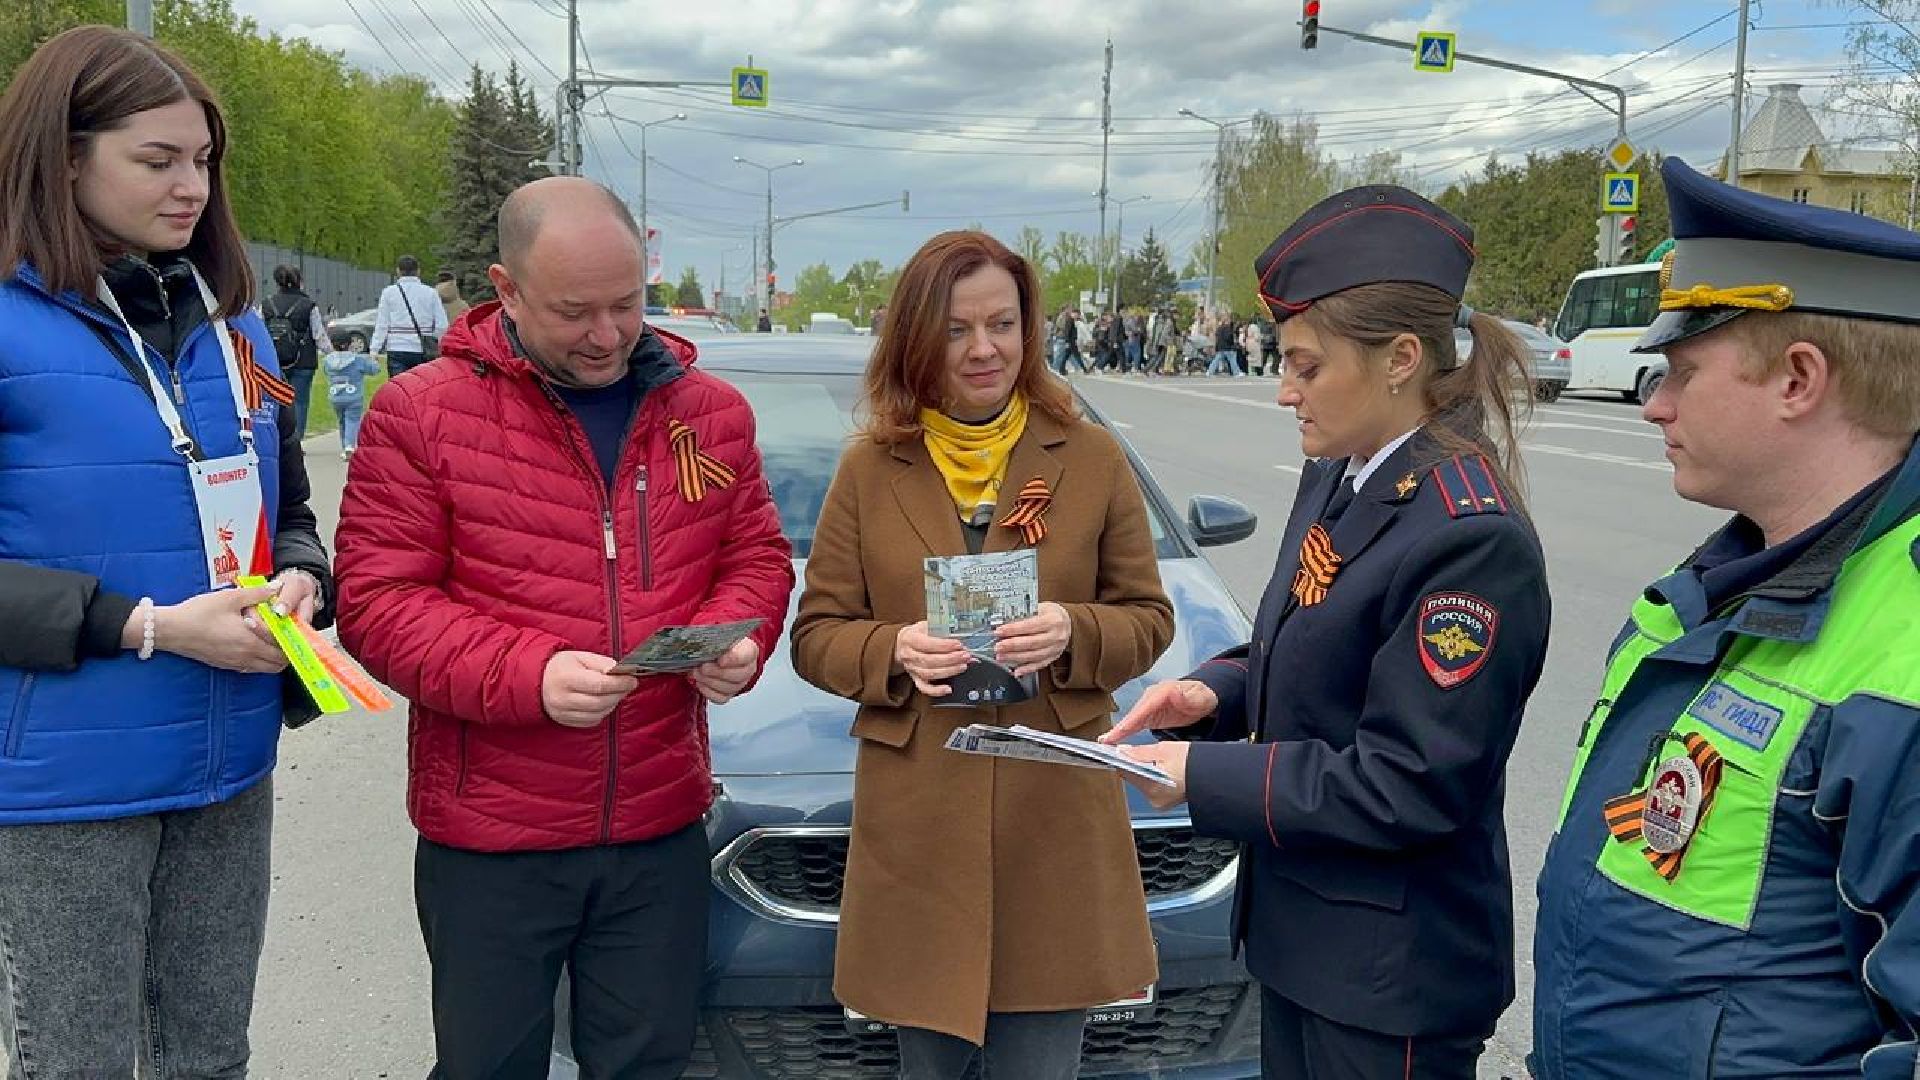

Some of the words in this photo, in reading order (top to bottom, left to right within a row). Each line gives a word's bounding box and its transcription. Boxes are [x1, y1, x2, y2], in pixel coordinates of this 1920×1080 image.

[1427, 597, 1492, 622] ПОЛИЦИЯ
[1431, 611, 1483, 634] РОССИЯ
[1721, 702, 1771, 739] ГИБДД
